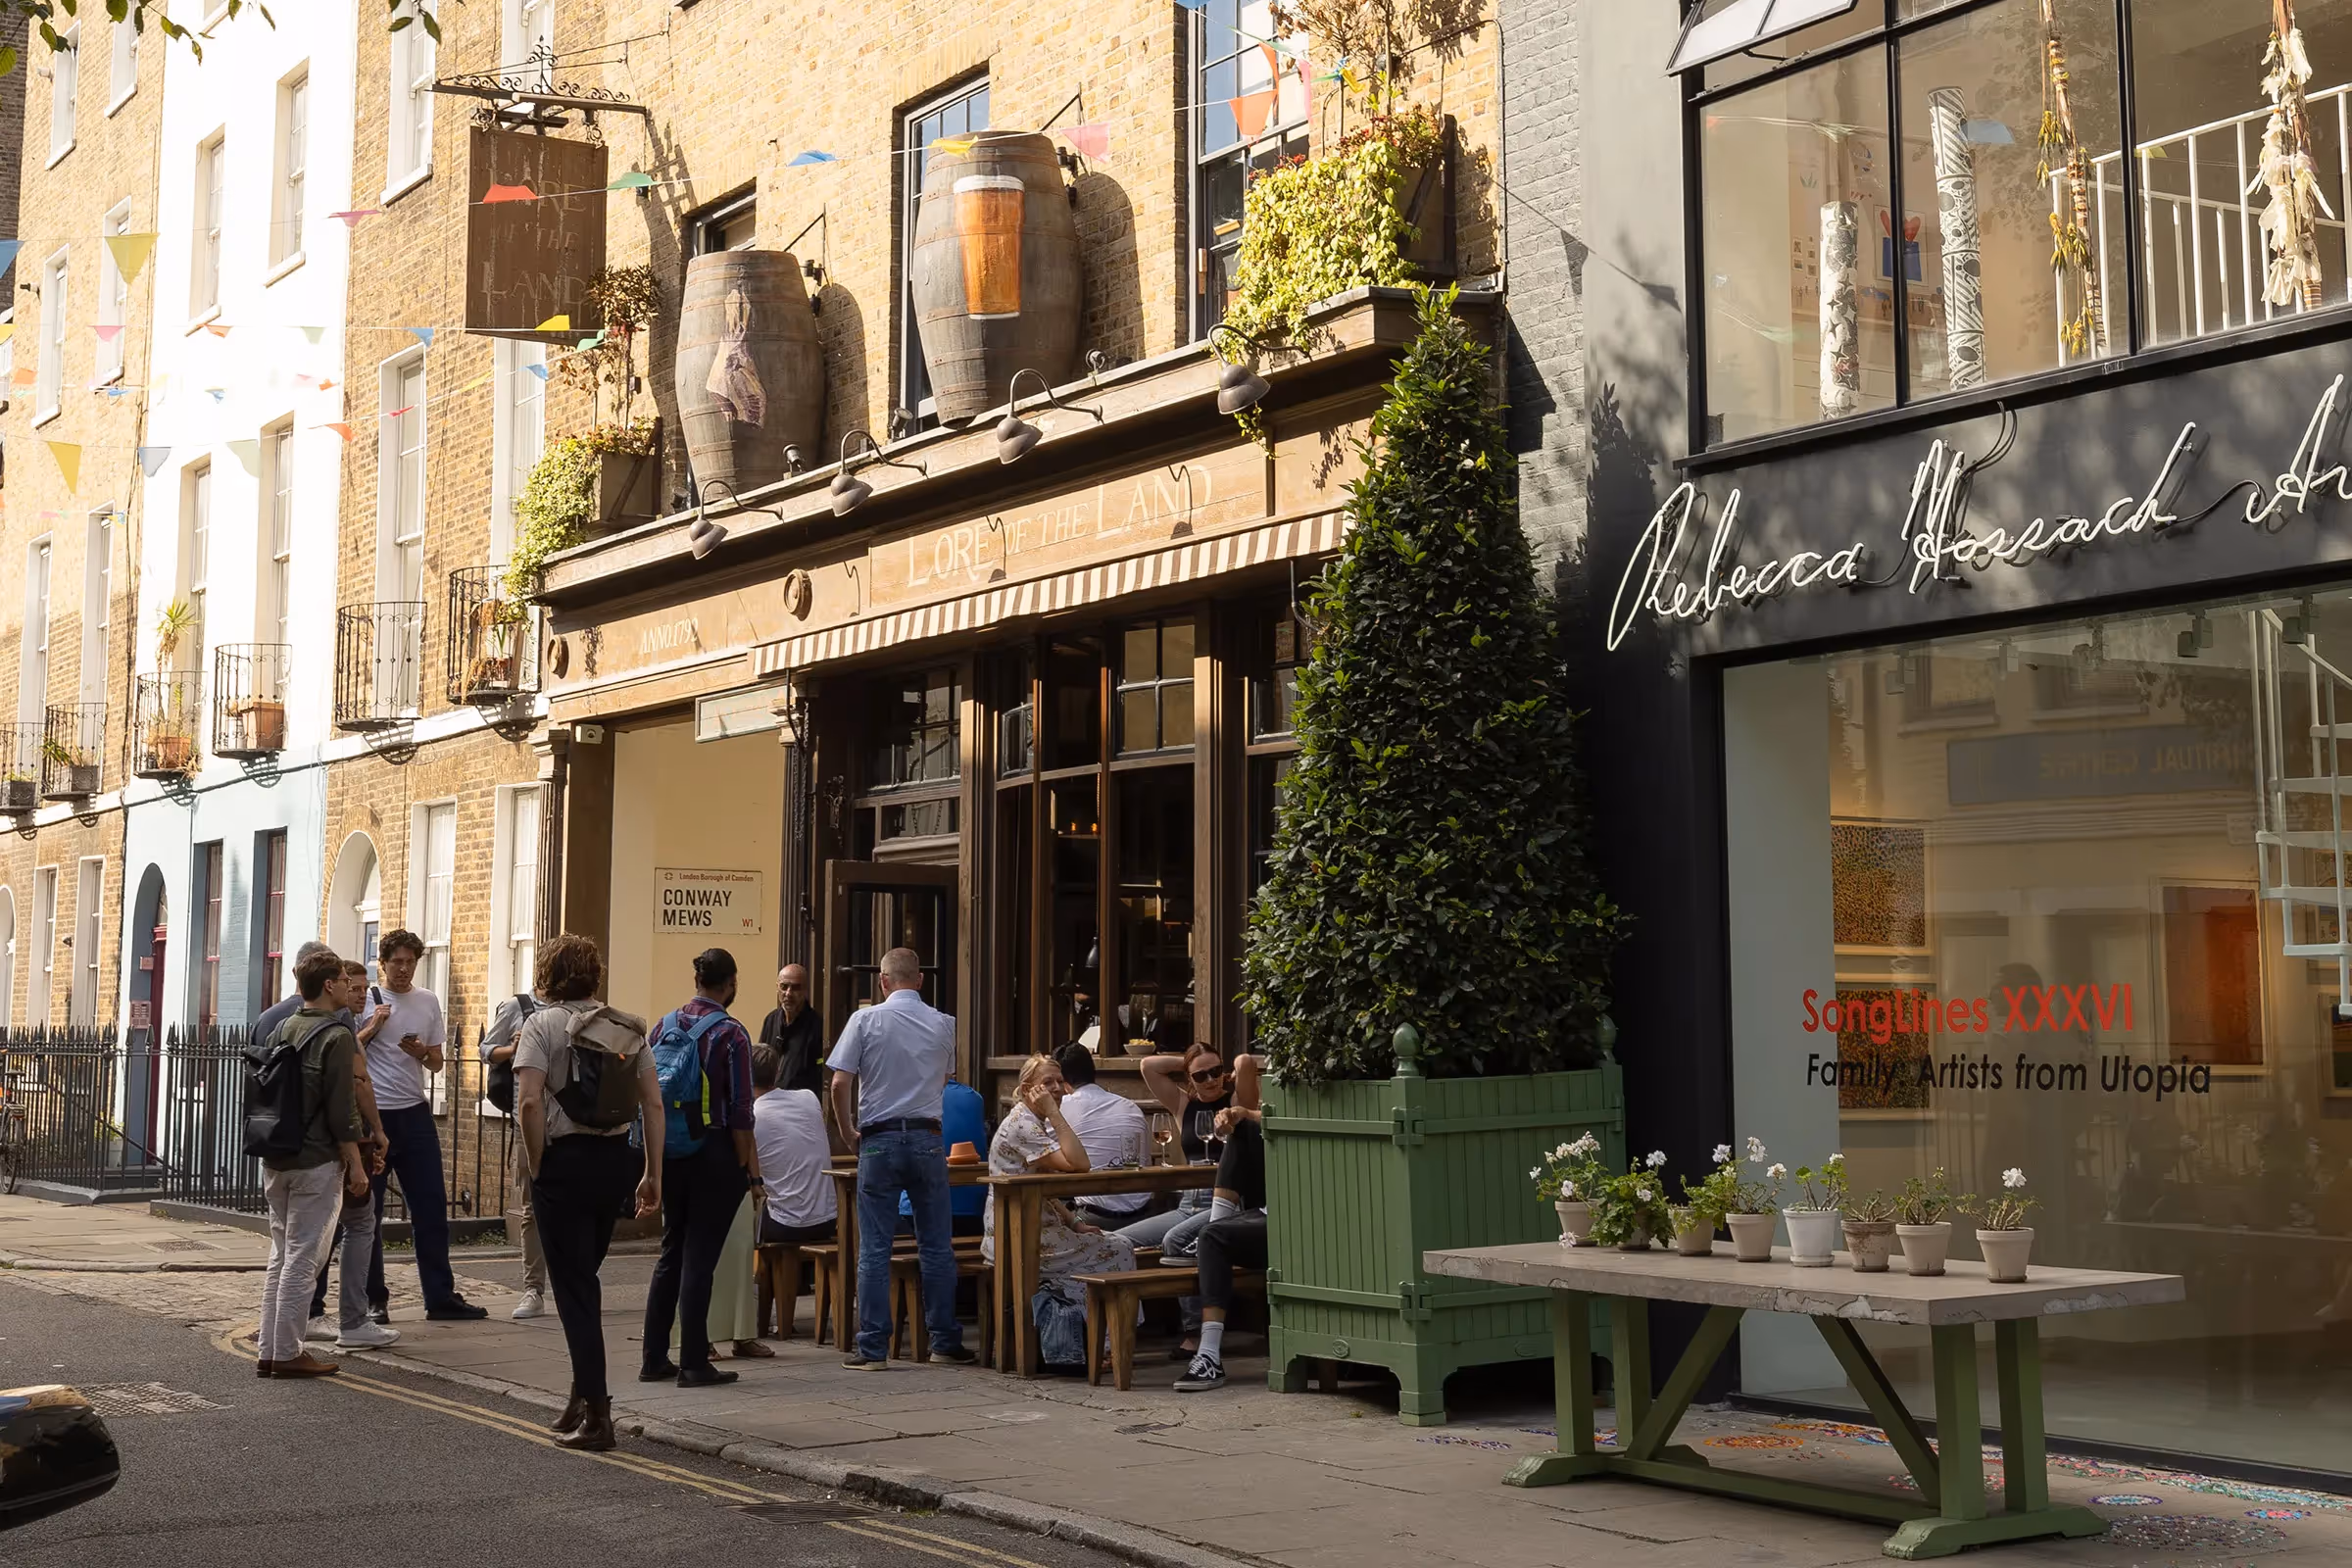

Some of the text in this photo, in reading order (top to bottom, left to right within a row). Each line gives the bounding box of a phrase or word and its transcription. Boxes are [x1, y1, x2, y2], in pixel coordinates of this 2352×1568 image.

[480, 261, 590, 306] LAND
[906, 464, 1213, 589] LORE OF THE LAND
[1606, 480, 1866, 654] Rebecca
[663, 888, 733, 906] CONWAY
[679, 872, 700, 881] London
[701, 873, 724, 882] Borough
[662, 908, 712, 927] MEWS
[742, 917, 754, 928] W1
[1801, 983, 2133, 1045] SongLines XXXVI
[1916, 1053, 2003, 1090] Artists
[2015, 1053, 2087, 1091] from
[2101, 1054, 2212, 1102] Utopia
